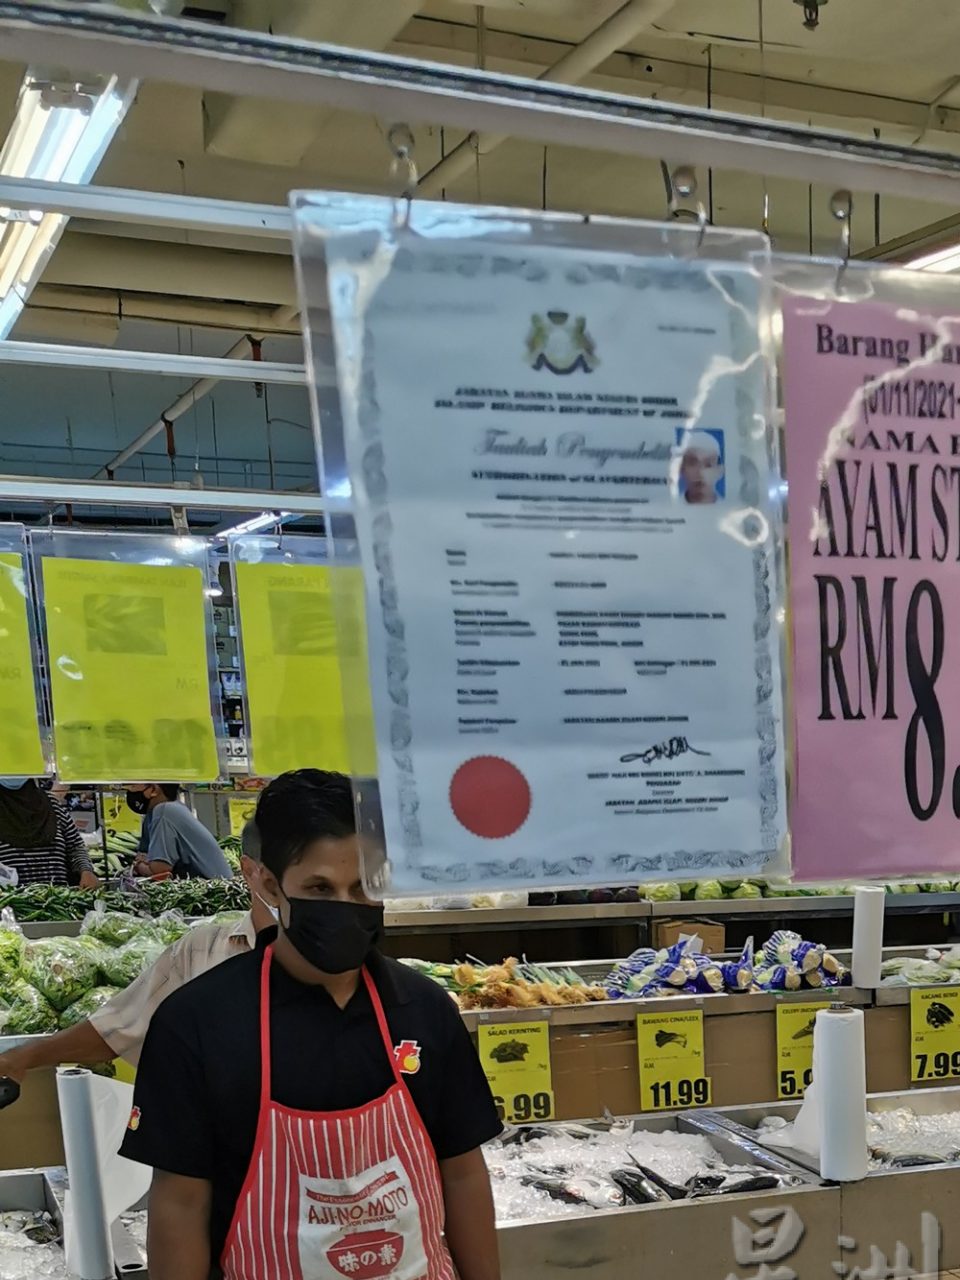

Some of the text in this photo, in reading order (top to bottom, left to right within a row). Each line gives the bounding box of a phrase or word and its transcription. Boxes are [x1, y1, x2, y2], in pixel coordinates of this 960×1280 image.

[816, 323, 910, 365] Barang
[836, 428, 941, 455] AMA
[812, 459, 921, 561] AYAM
[650, 1078, 709, 1107] 11.99
[338, 1243, 397, 1272] 味の素
